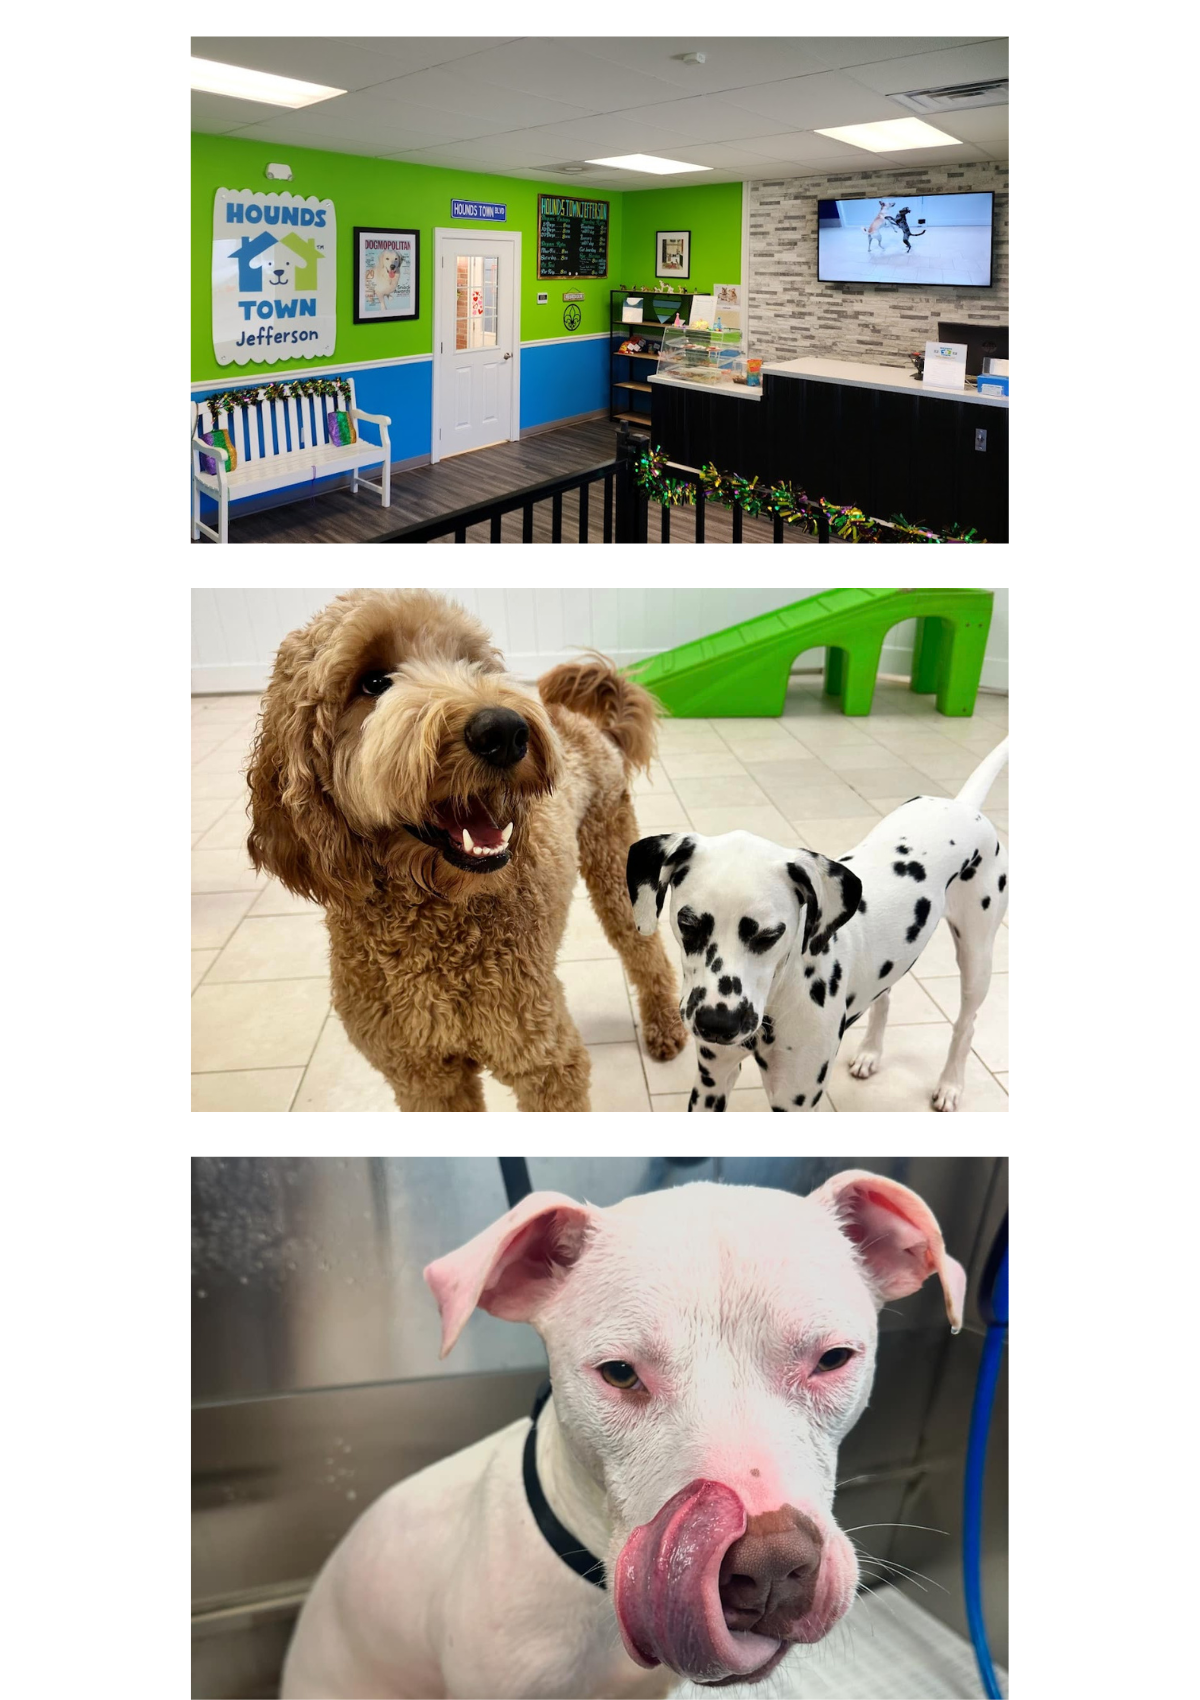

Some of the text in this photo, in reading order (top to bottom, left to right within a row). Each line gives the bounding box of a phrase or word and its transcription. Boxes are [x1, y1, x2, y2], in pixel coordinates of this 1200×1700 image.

[226, 202, 327, 228] HOUNDS
[453, 202, 478, 217] HOUNDS
[479, 205, 495, 218] TOWN
[541, 197, 565, 216] HOUNDS
[580, 201, 607, 220] JEFFERSON
[365, 240, 411, 250] DOGMOPOLITAN
[238, 298, 317, 321] TOWN
[236, 325, 319, 348] Jefferson
